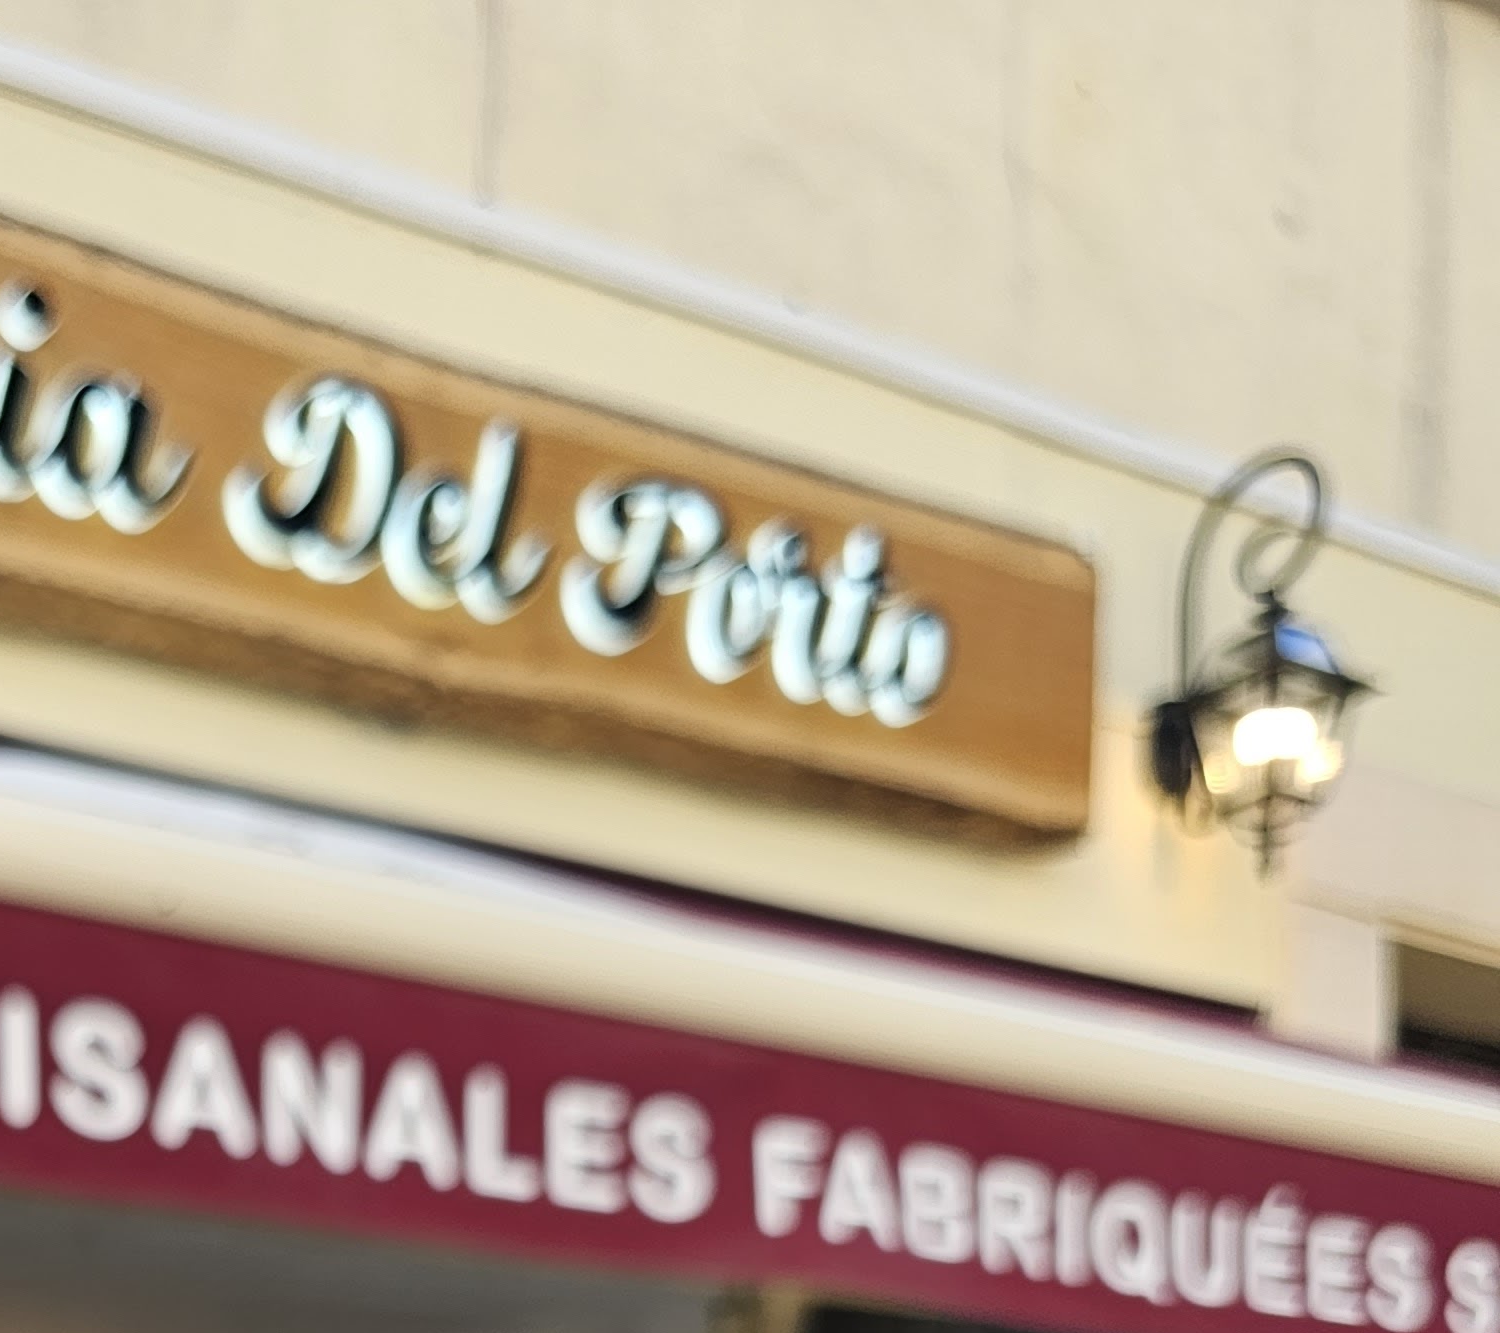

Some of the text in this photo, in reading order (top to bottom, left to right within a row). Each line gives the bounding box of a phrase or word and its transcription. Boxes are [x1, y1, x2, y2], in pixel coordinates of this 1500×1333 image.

[222, 374, 553, 626] Del
[558, 478, 950, 729] Porto
[750, 1118, 1434, 1333] FABRIQUÉES
